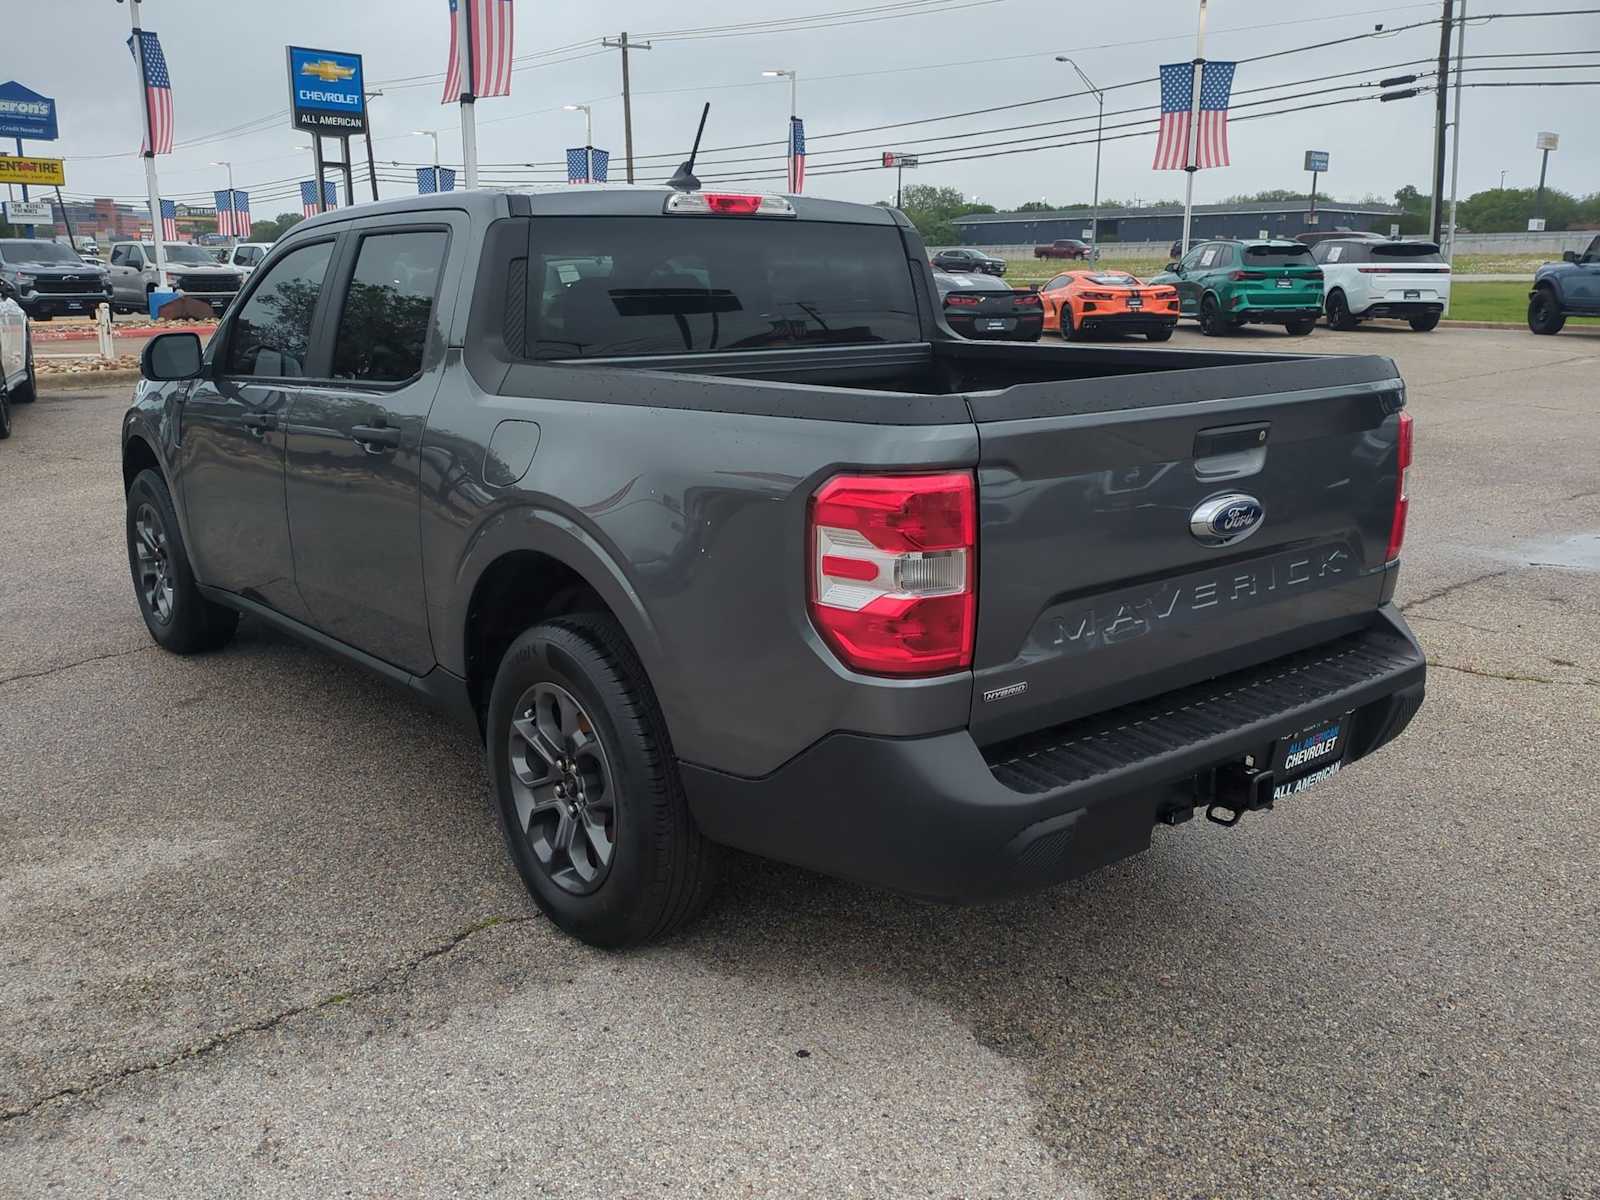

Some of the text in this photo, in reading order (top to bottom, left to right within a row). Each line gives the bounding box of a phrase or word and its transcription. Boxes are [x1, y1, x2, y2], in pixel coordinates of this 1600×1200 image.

[299, 90, 360, 105] CHEVROLET
[301, 114, 363, 128] ALL AMERICAN
[31, 161, 59, 174] TIRE
[1224, 506, 1256, 530] Ford
[1052, 549, 1350, 645] MAVERICK
[985, 683, 1027, 701] HYBRID
[1285, 736, 1338, 769] CHEVROLET
[1289, 742, 1302, 754] ALL
[1273, 760, 1341, 800] ALL AMERICAN
